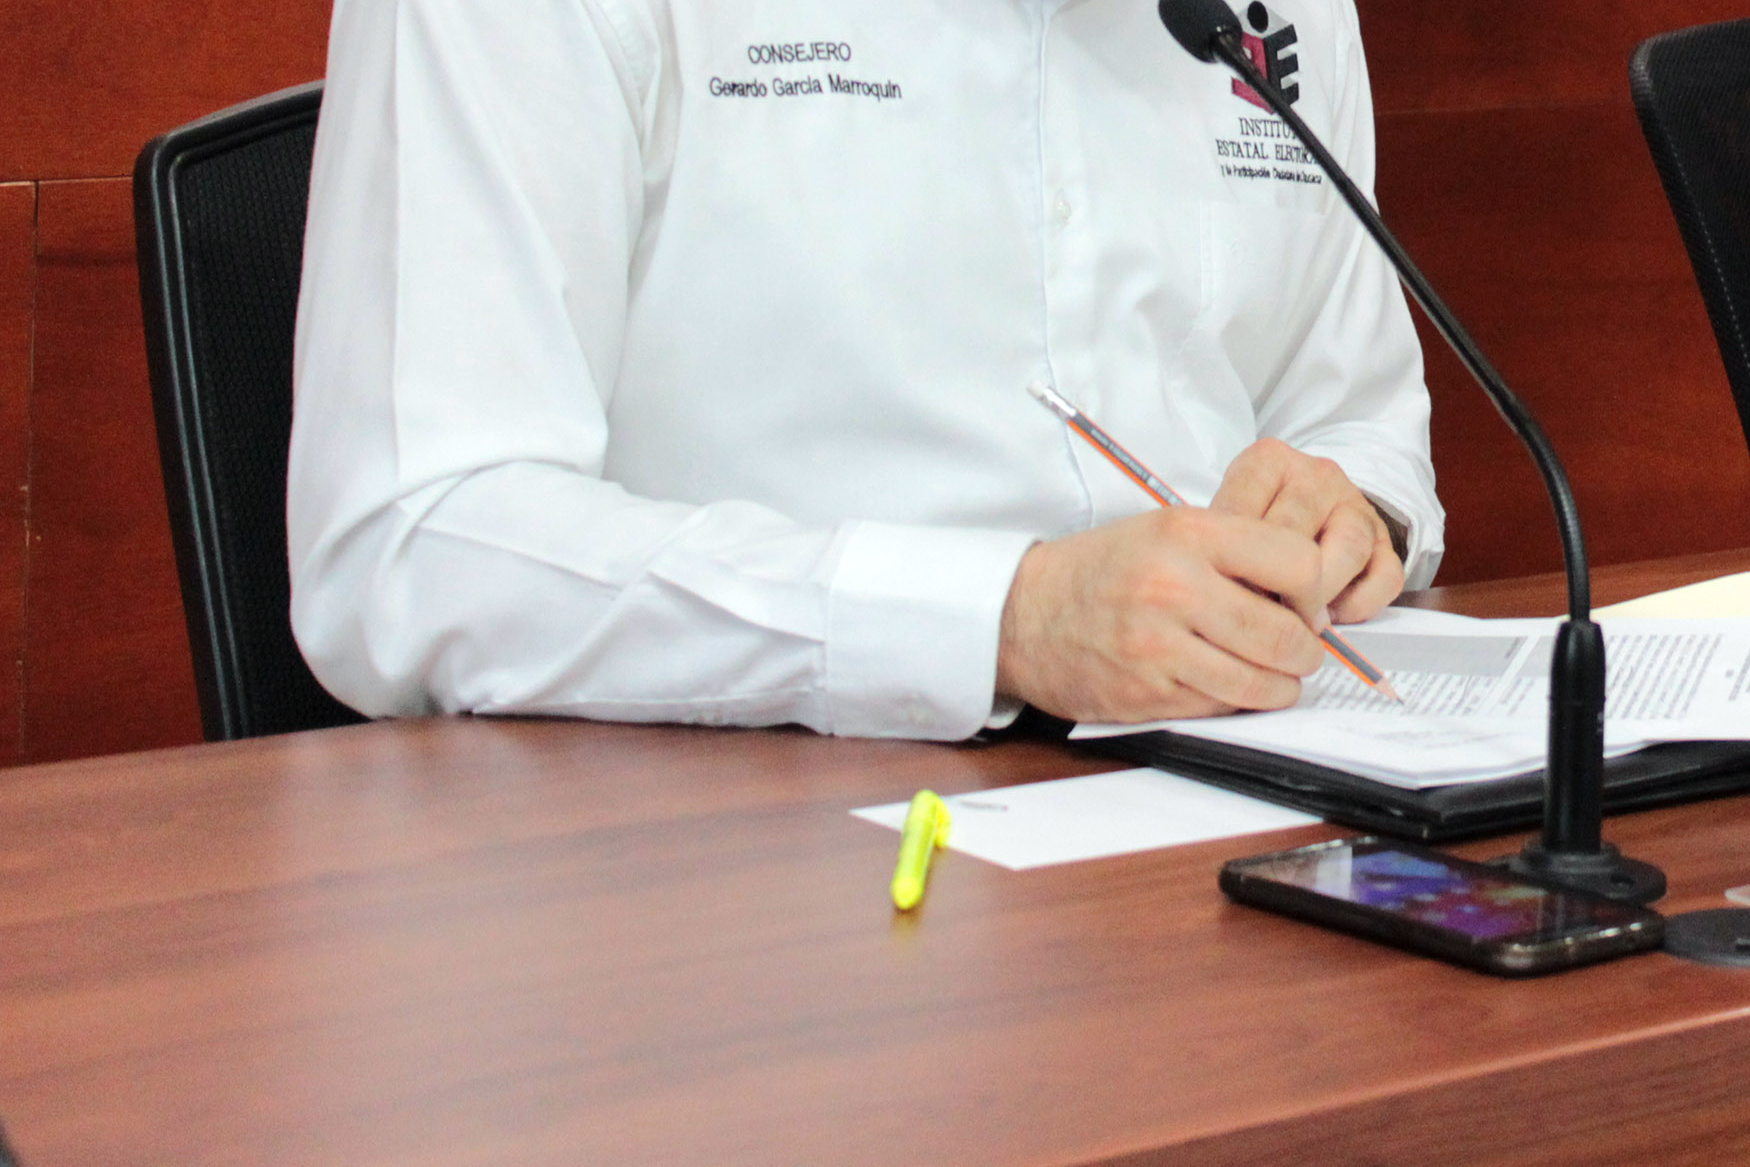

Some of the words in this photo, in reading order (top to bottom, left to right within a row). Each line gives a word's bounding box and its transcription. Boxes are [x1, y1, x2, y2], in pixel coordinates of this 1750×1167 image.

[747, 41, 852, 65] CONSEJERO
[709, 75, 768, 97] Gerardo
[1239, 117, 1298, 140] INSTITU
[1215, 138, 1270, 161] ESTATAL
